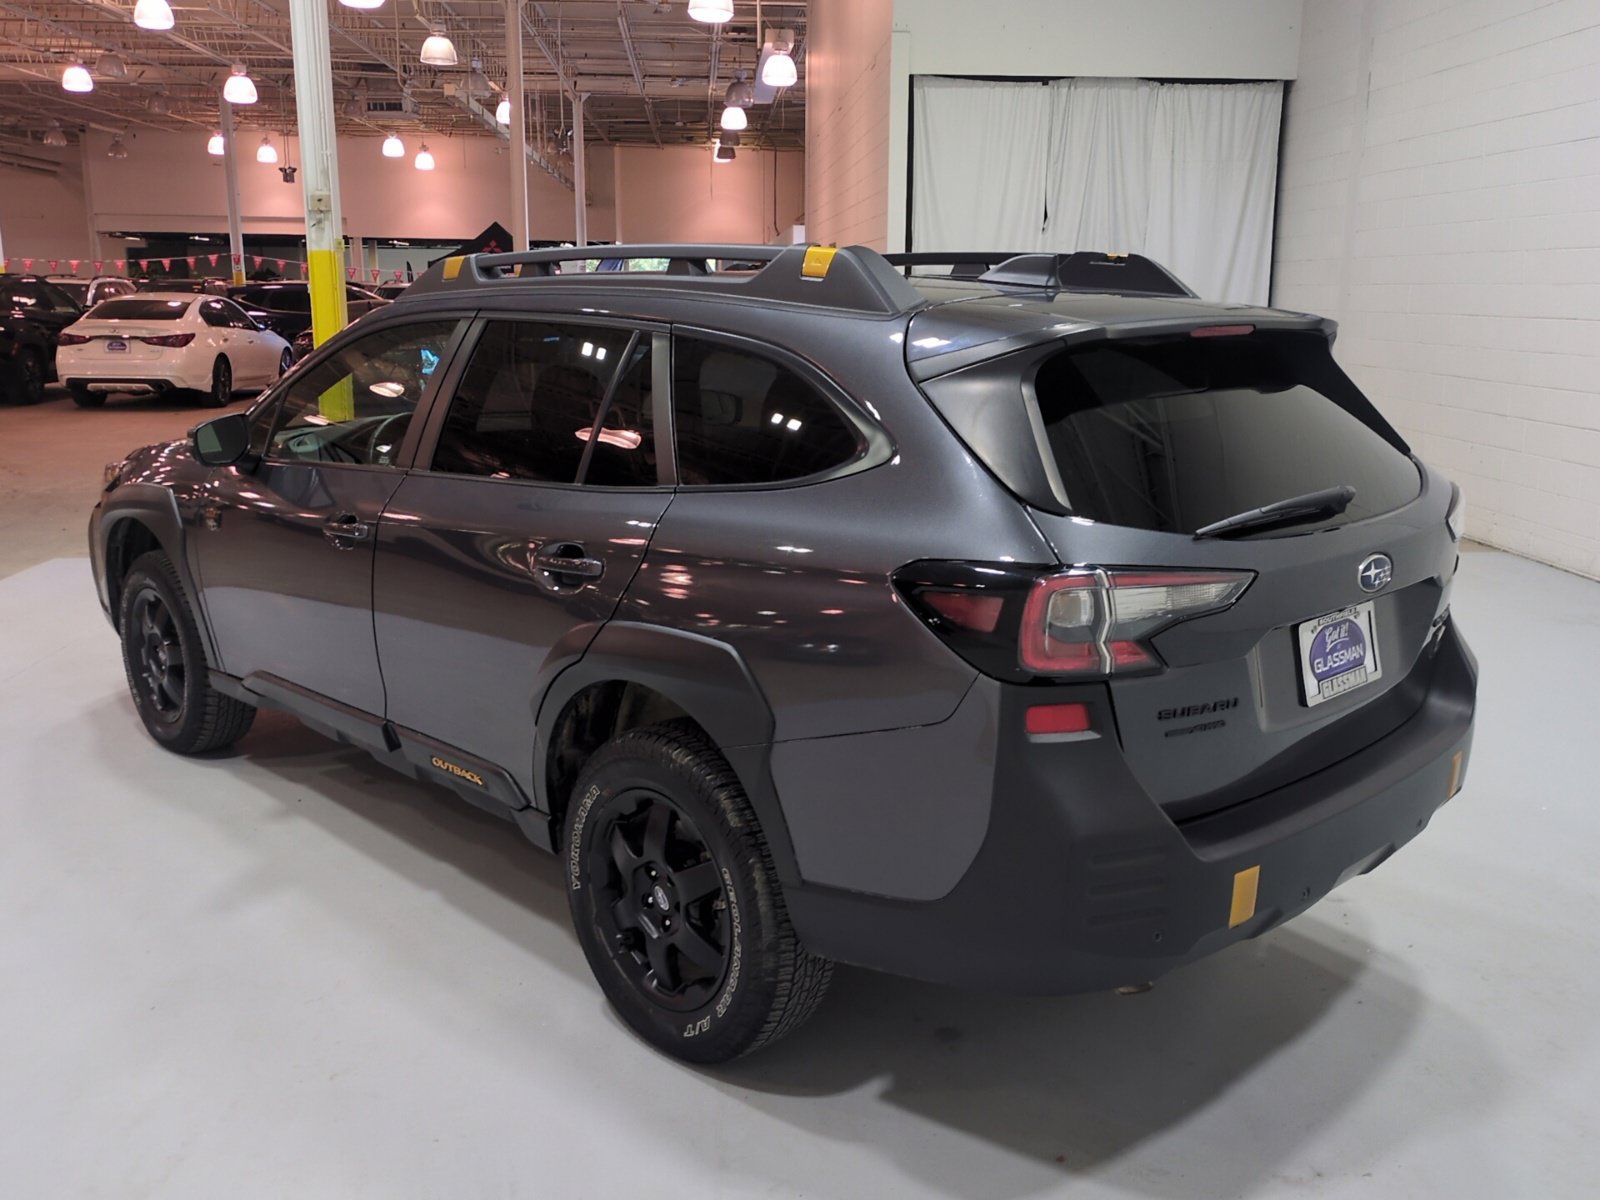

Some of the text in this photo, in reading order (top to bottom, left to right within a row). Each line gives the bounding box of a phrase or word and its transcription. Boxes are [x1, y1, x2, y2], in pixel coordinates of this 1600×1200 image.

[1314, 643, 1363, 673] GLASSMAN
[1157, 697, 1239, 721] SUBARU
[432, 757, 483, 785] OUTBACK
[569, 784, 600, 890] YOKOHAMA
[684, 868, 742, 1037] GEOLANDAR A/T
